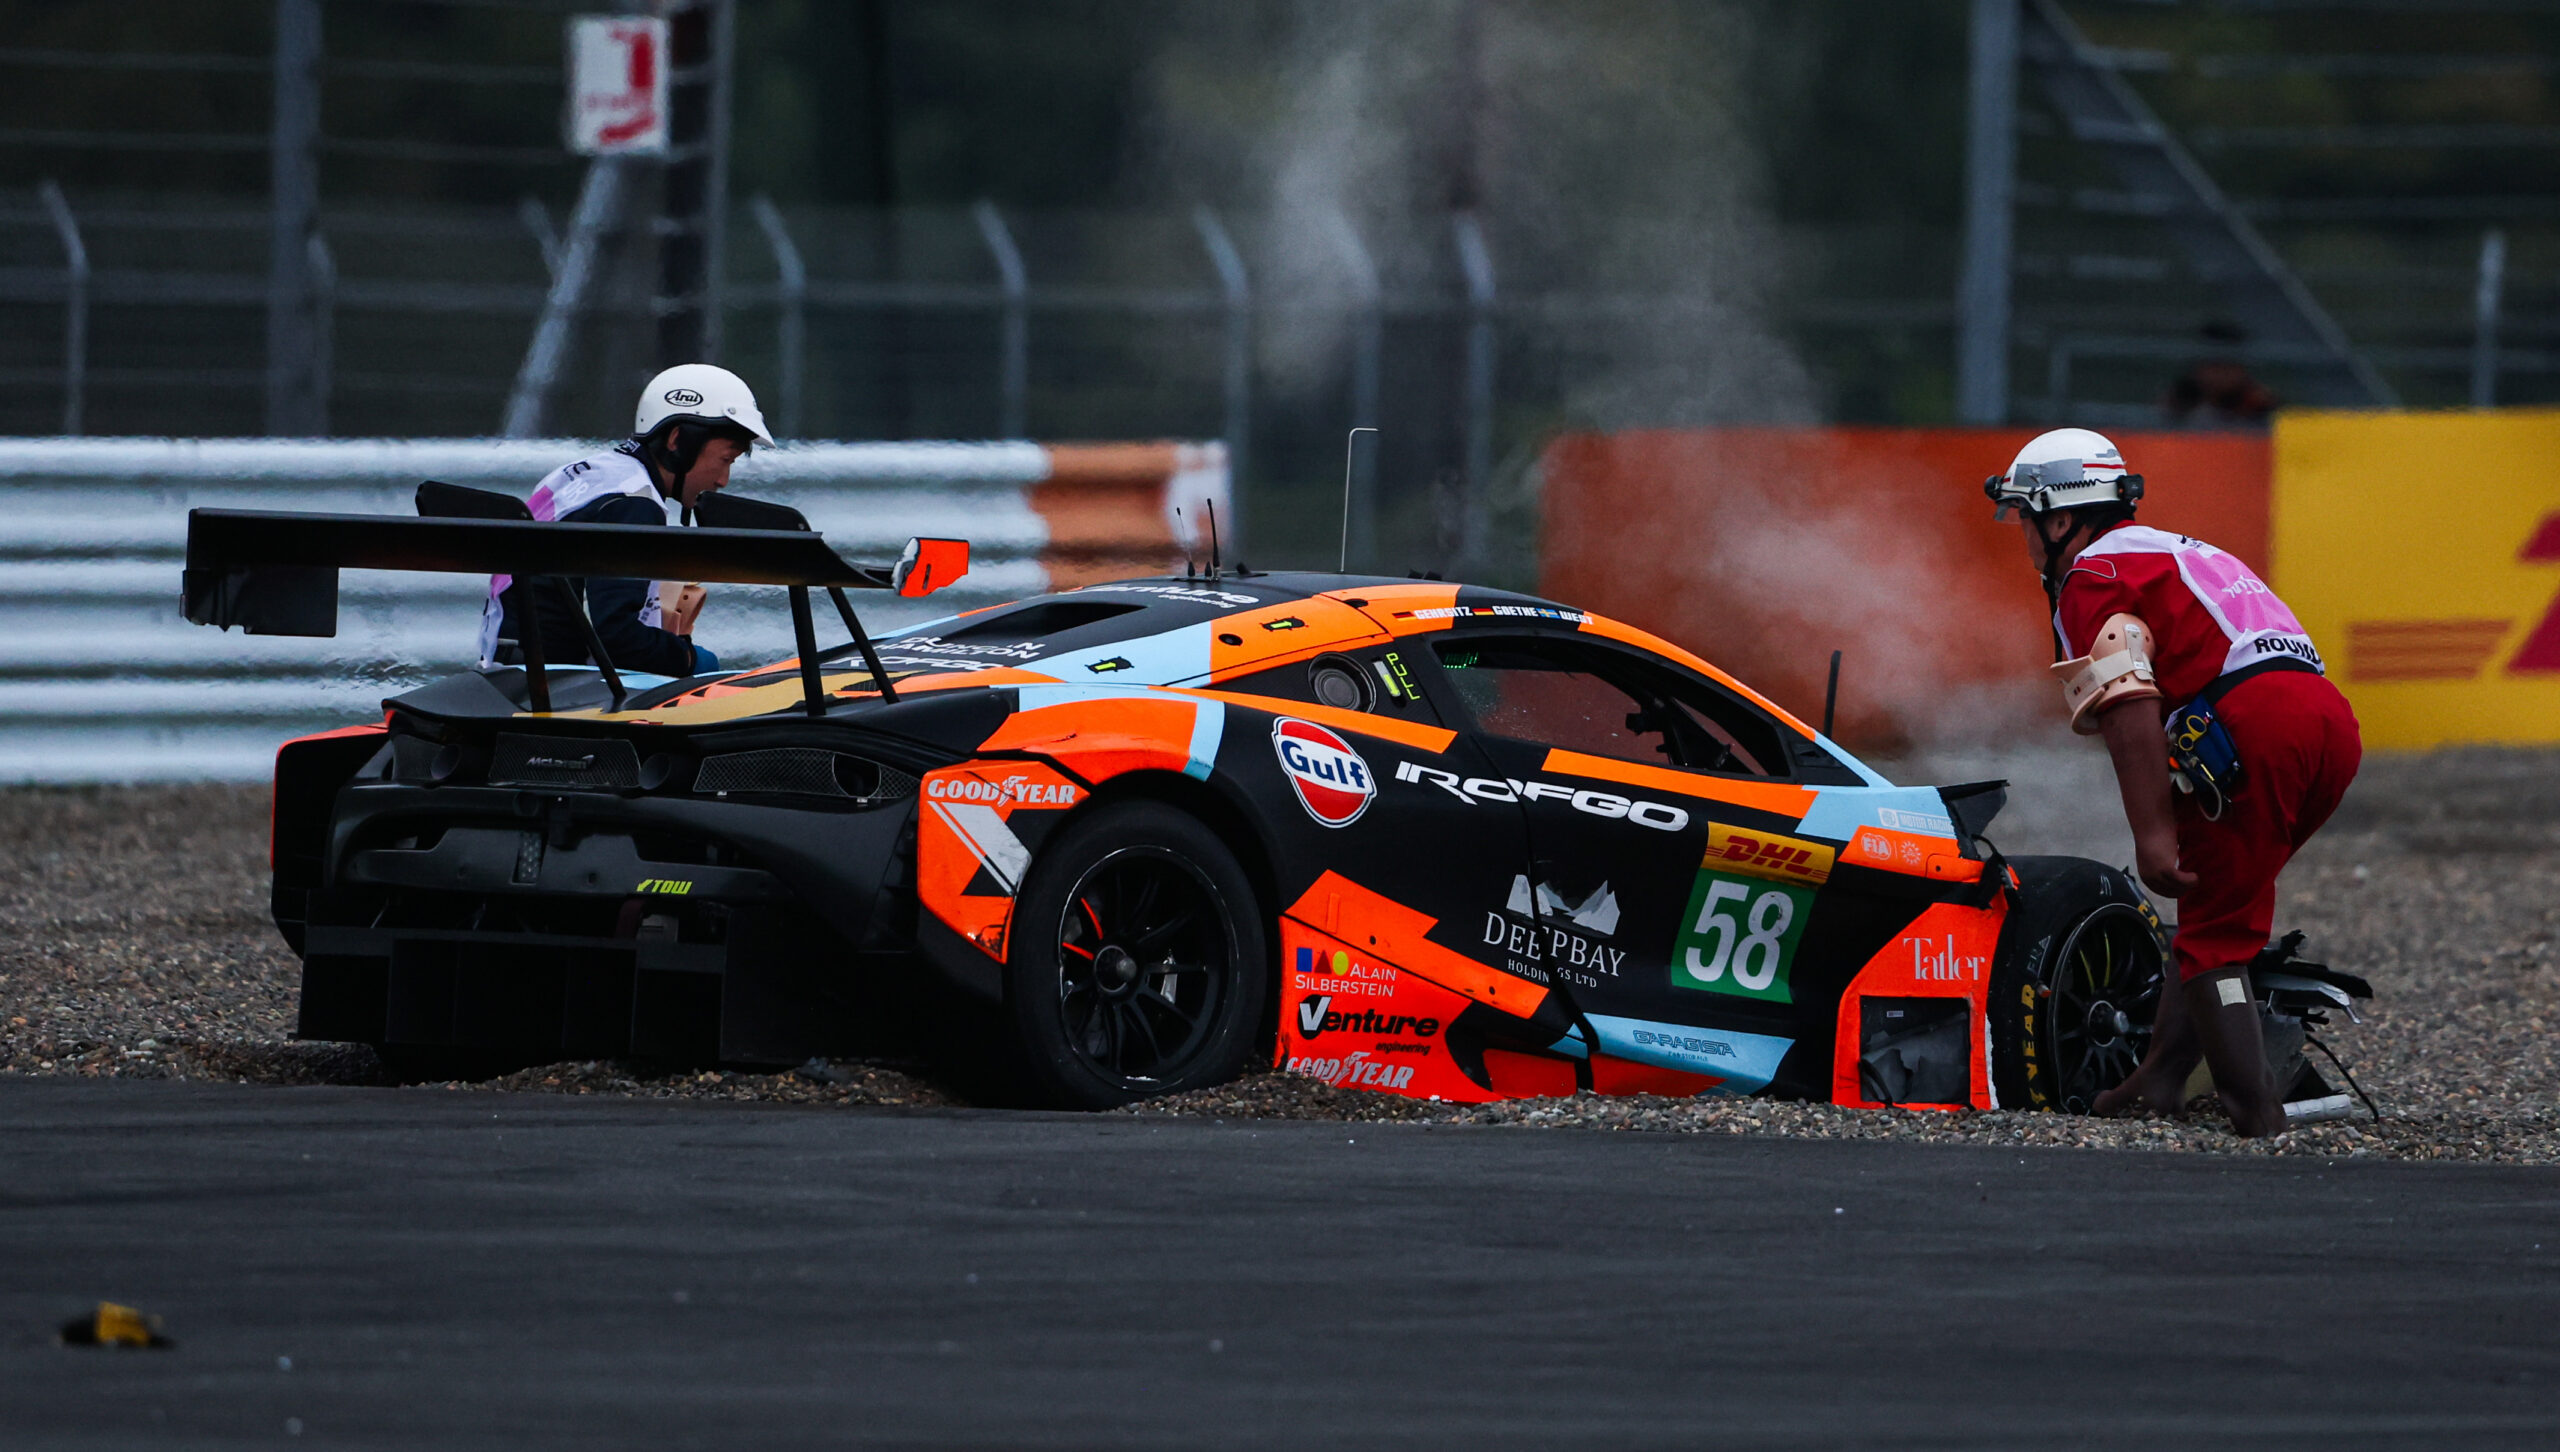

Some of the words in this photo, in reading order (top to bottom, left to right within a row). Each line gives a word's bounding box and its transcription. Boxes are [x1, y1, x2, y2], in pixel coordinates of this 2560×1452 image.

[1413, 606, 1474, 620] GEHRSITZ
[1492, 605, 1539, 617] GOETHE
[1559, 610, 1595, 625] WEST
[1386, 653, 1420, 700] PULL
[1281, 740, 1365, 789] Gulf
[1395, 760, 1690, 832] ROFGO
[1722, 835, 1813, 876] DHL
[1862, 836, 1889, 855] FIA
[651, 880, 693, 895] TOW
[1483, 911, 1627, 977] DEEPBAY
[1684, 879, 1794, 991] 58
[1903, 933, 1986, 981] Tatler
[1575, 972, 1597, 988] LTD
[1298, 996, 1440, 1038] Venture
[1375, 1041, 1432, 1056] engineering
